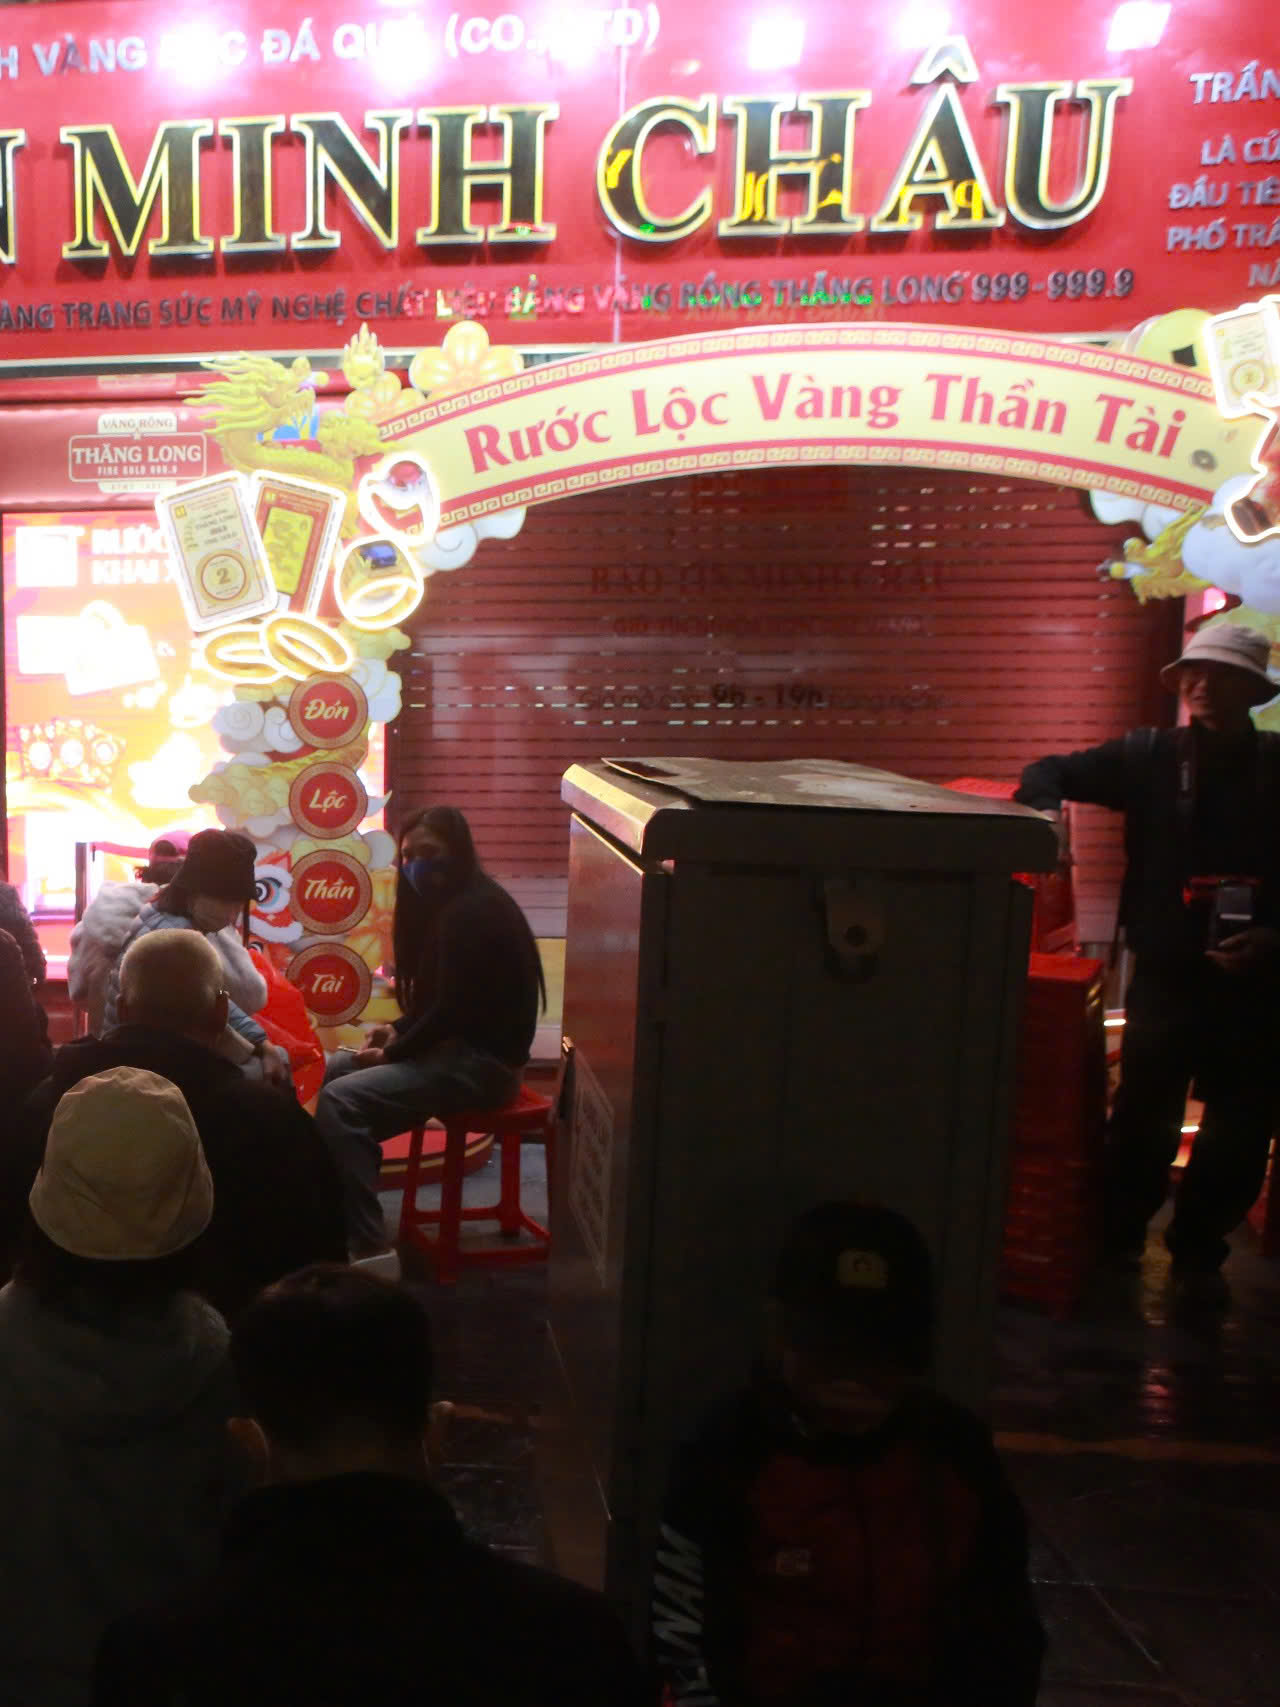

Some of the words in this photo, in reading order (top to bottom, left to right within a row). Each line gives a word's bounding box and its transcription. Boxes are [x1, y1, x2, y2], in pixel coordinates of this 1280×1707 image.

[33, 33, 147, 76] VÀNG
[260, 17, 320, 64] ĐÁ
[60, 104, 559, 260] MINH
[596, 35, 1133, 243] CHÂU
[1200, 133, 1236, 166] LÀ
[62, 300, 152, 328] TRANG
[159, 289, 213, 325] SỨC
[220, 289, 261, 322] MỸ
[271, 287, 347, 327] NGHỆ
[592, 274, 672, 317] VÀNG
[465, 406, 611, 472] Rước
[631, 384, 729, 442] Lộc
[751, 371, 902, 430] Vàng
[926, 371, 1068, 437] Thần
[1093, 391, 1190, 460] Tài
[72, 443, 142, 464] THĂNG
[147, 445, 201, 462] LONG
[216, 567, 231, 585] 2
[775, 683, 822, 707] 19h
[304, 698, 350, 721] Đón
[307, 788, 348, 814] Lộc
[305, 877, 355, 900] Thần
[311, 972, 344, 994] Tài
